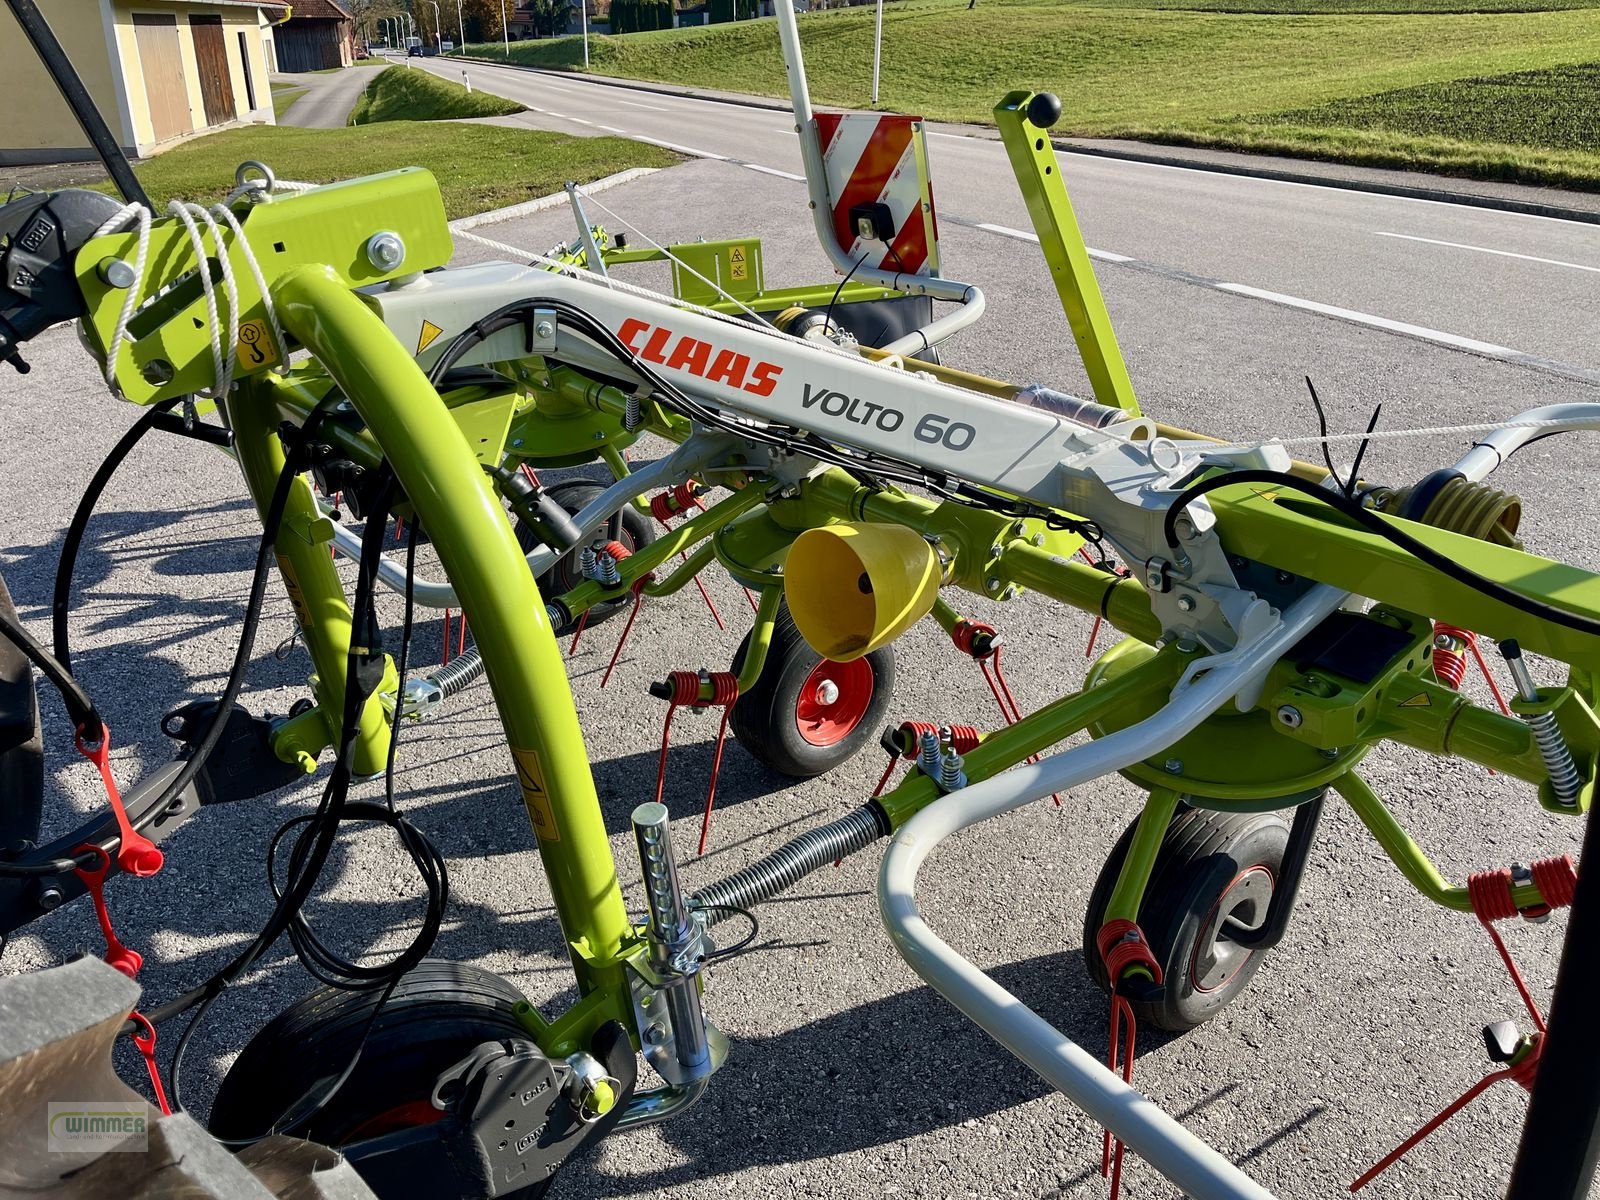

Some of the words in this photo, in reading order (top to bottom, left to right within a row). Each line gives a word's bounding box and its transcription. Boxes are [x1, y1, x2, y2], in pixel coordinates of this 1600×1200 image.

[616, 318, 784, 397] CLAAS
[802, 383, 904, 432] VOLTO
[913, 413, 977, 452] 60
